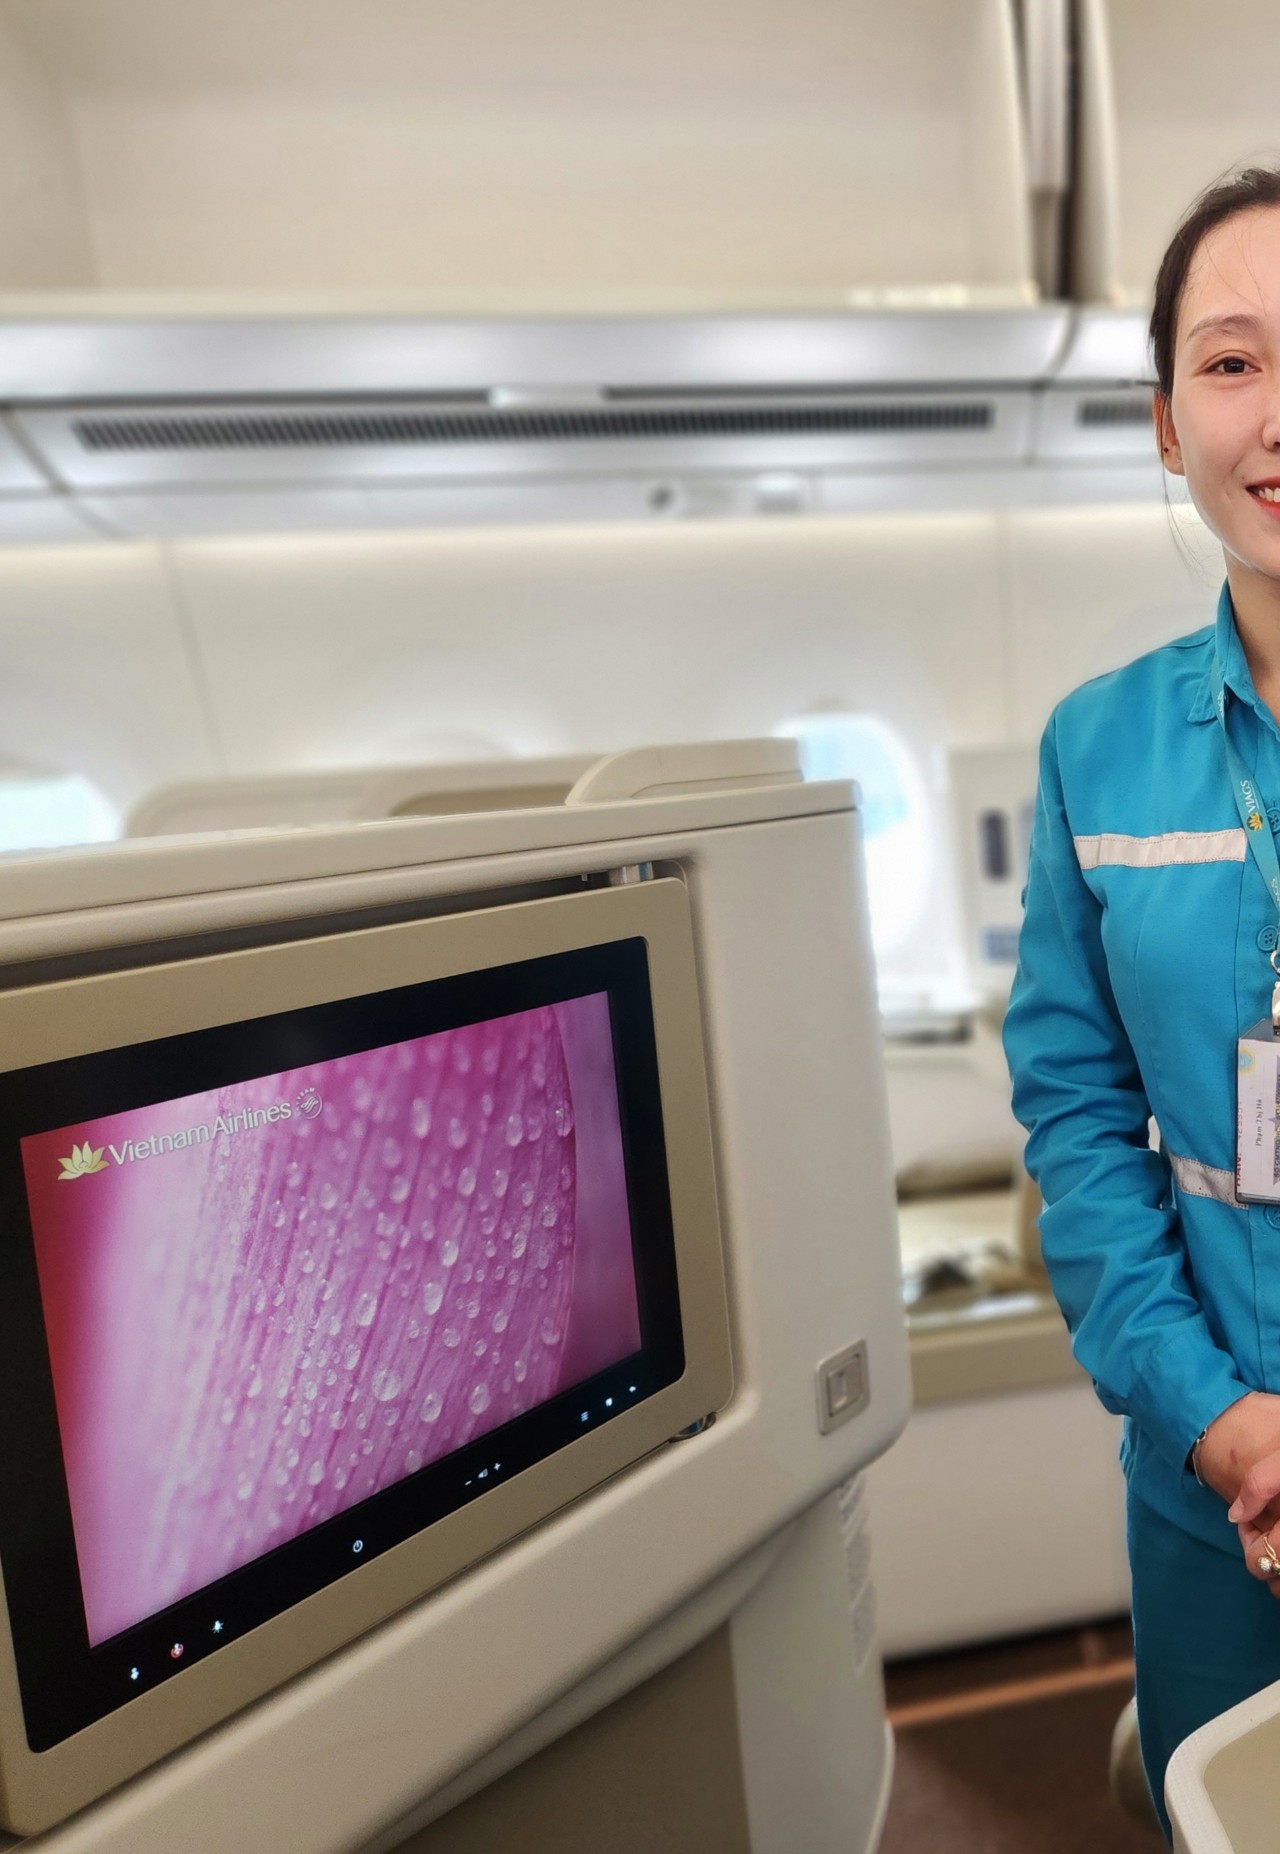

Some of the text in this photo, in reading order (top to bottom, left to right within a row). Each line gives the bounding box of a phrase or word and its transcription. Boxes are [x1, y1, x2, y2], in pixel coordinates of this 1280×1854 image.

[1239, 779, 1256, 813] VIAGS
[108, 1100, 292, 1166] Vietnam Airlines
